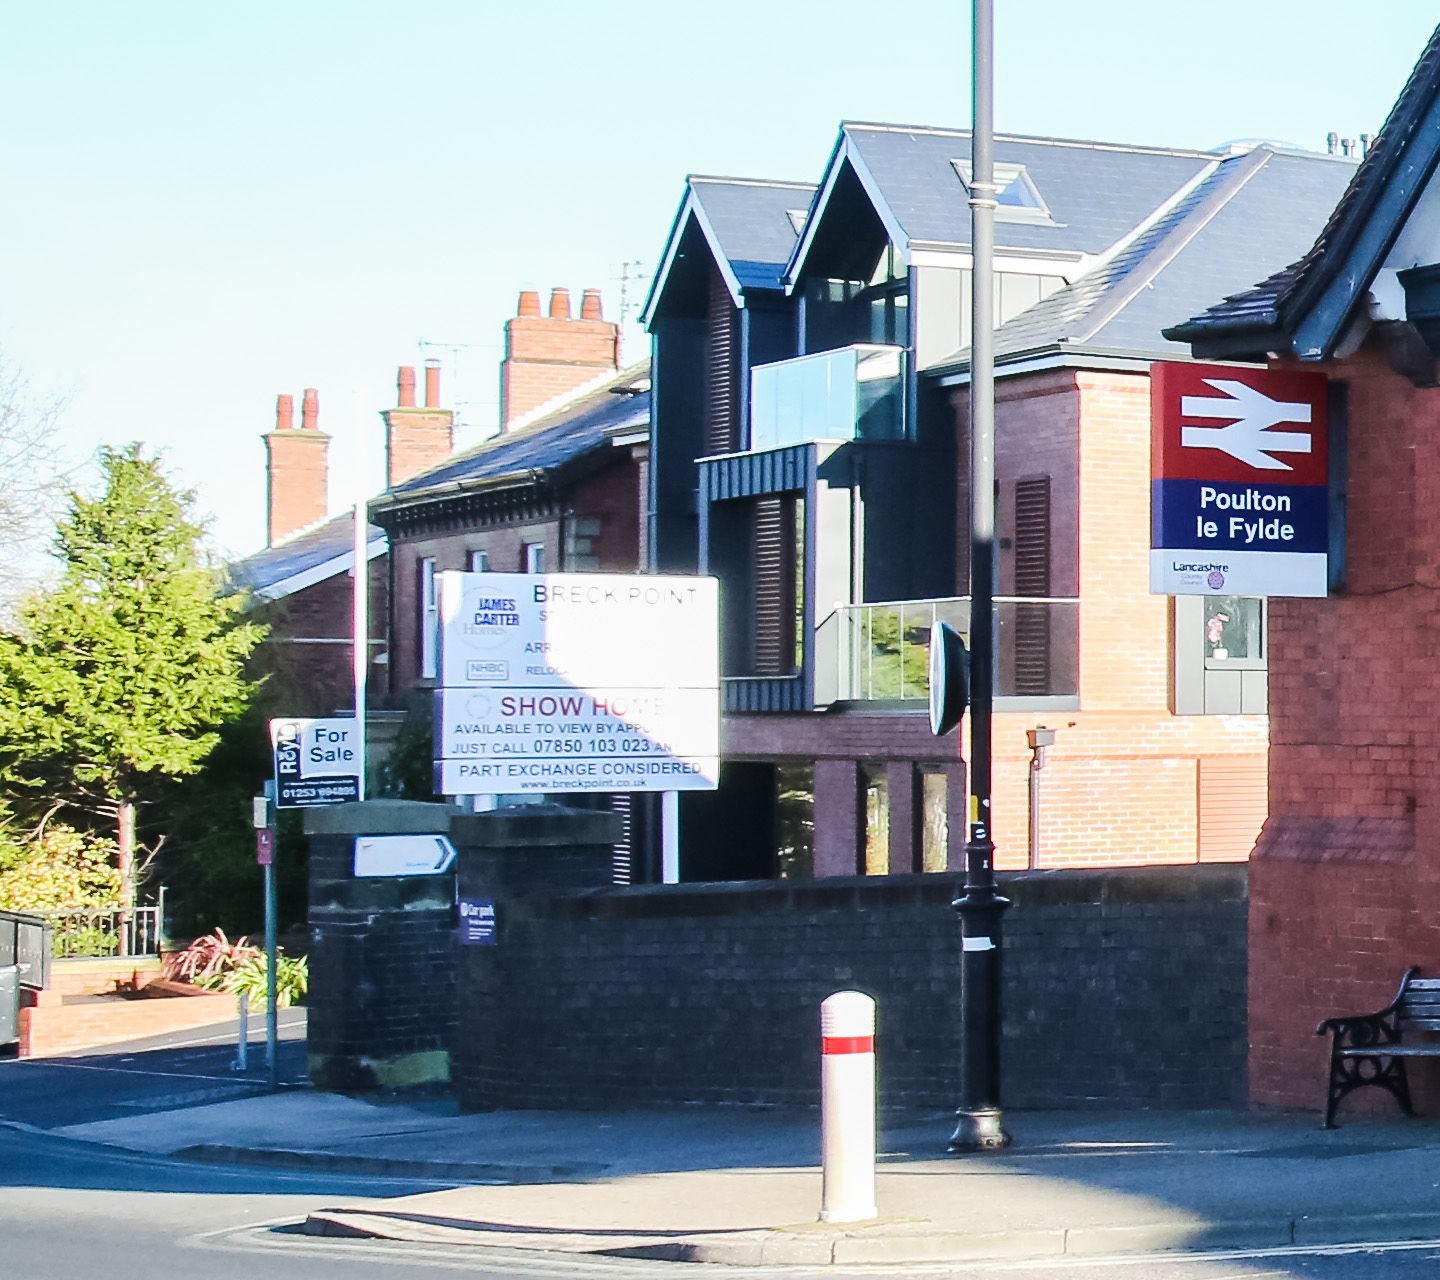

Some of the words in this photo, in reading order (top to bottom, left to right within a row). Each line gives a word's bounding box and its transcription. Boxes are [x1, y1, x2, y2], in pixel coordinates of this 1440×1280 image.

[1200, 486, 1291, 512] Poulton
[1196, 515, 1219, 538] le
[1229, 517, 1295, 544] Fylde
[1172, 561, 1229, 573] Lancashire
[533, 584, 618, 605] BRECK
[629, 587, 697, 606] POINT
[478, 598, 516, 612] JAMES
[474, 613, 520, 626] CARTER
[470, 663, 505, 674] NHBC
[500, 696, 584, 718] SHOW
[315, 728, 348, 743] For
[454, 723, 531, 735] AVAILABLE
[537, 723, 554, 734] TO
[559, 723, 592, 734] VIEW
[596, 723, 612, 734] BY
[451, 742, 487, 754] JUST
[492, 742, 528, 753] CALL
[533, 739, 583, 753] 07850
[588, 738, 617, 753] 103
[622, 738, 650, 752] 023
[310, 746, 354, 762] Sale
[459, 764, 501, 777] PART
[508, 763, 598, 776] EXCHANGE
[602, 762, 702, 776] CONSIDERED
[520, 778, 647, 790] www.breckpoint.co.uk
